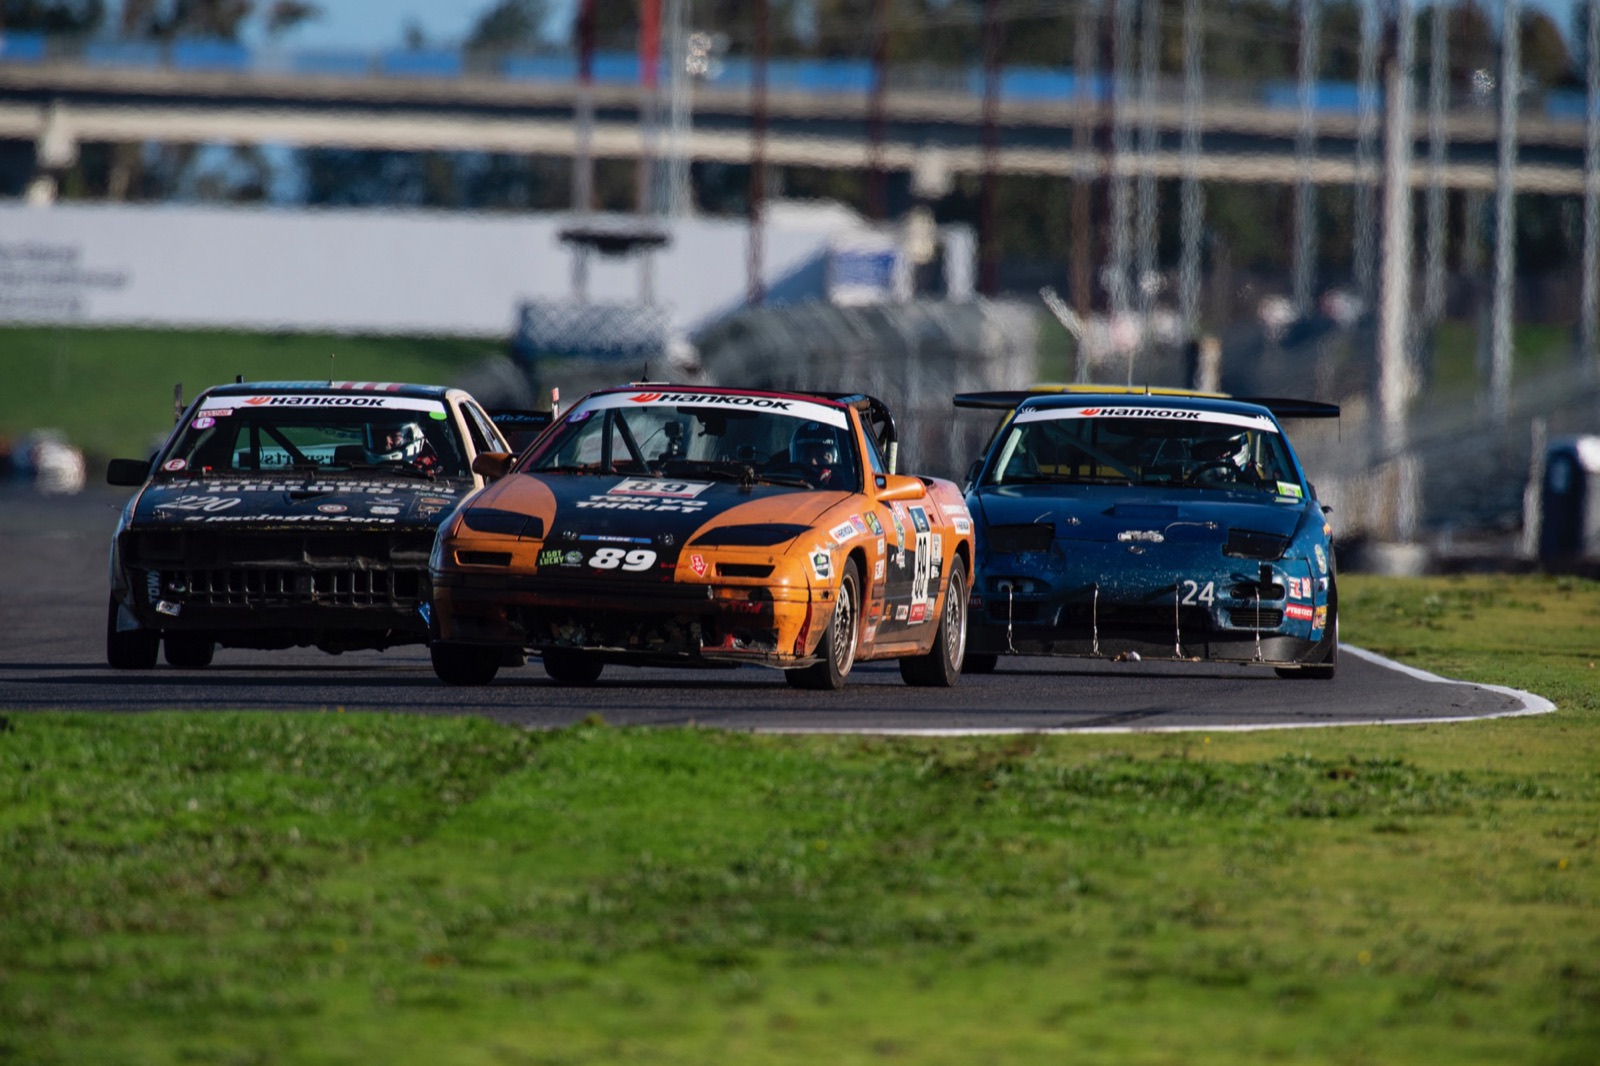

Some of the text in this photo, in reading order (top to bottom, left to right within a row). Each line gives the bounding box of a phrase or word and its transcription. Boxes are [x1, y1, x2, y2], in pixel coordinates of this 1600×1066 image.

[628, 481, 689, 493] 89
[155, 495, 242, 512] 220
[575, 501, 703, 514] THRIFT
[539, 555, 564, 566] LUCKY
[546, 549, 562, 559] GOT
[588, 547, 658, 573] 89
[915, 536, 927, 600] 89
[1181, 579, 1215, 607] 24
